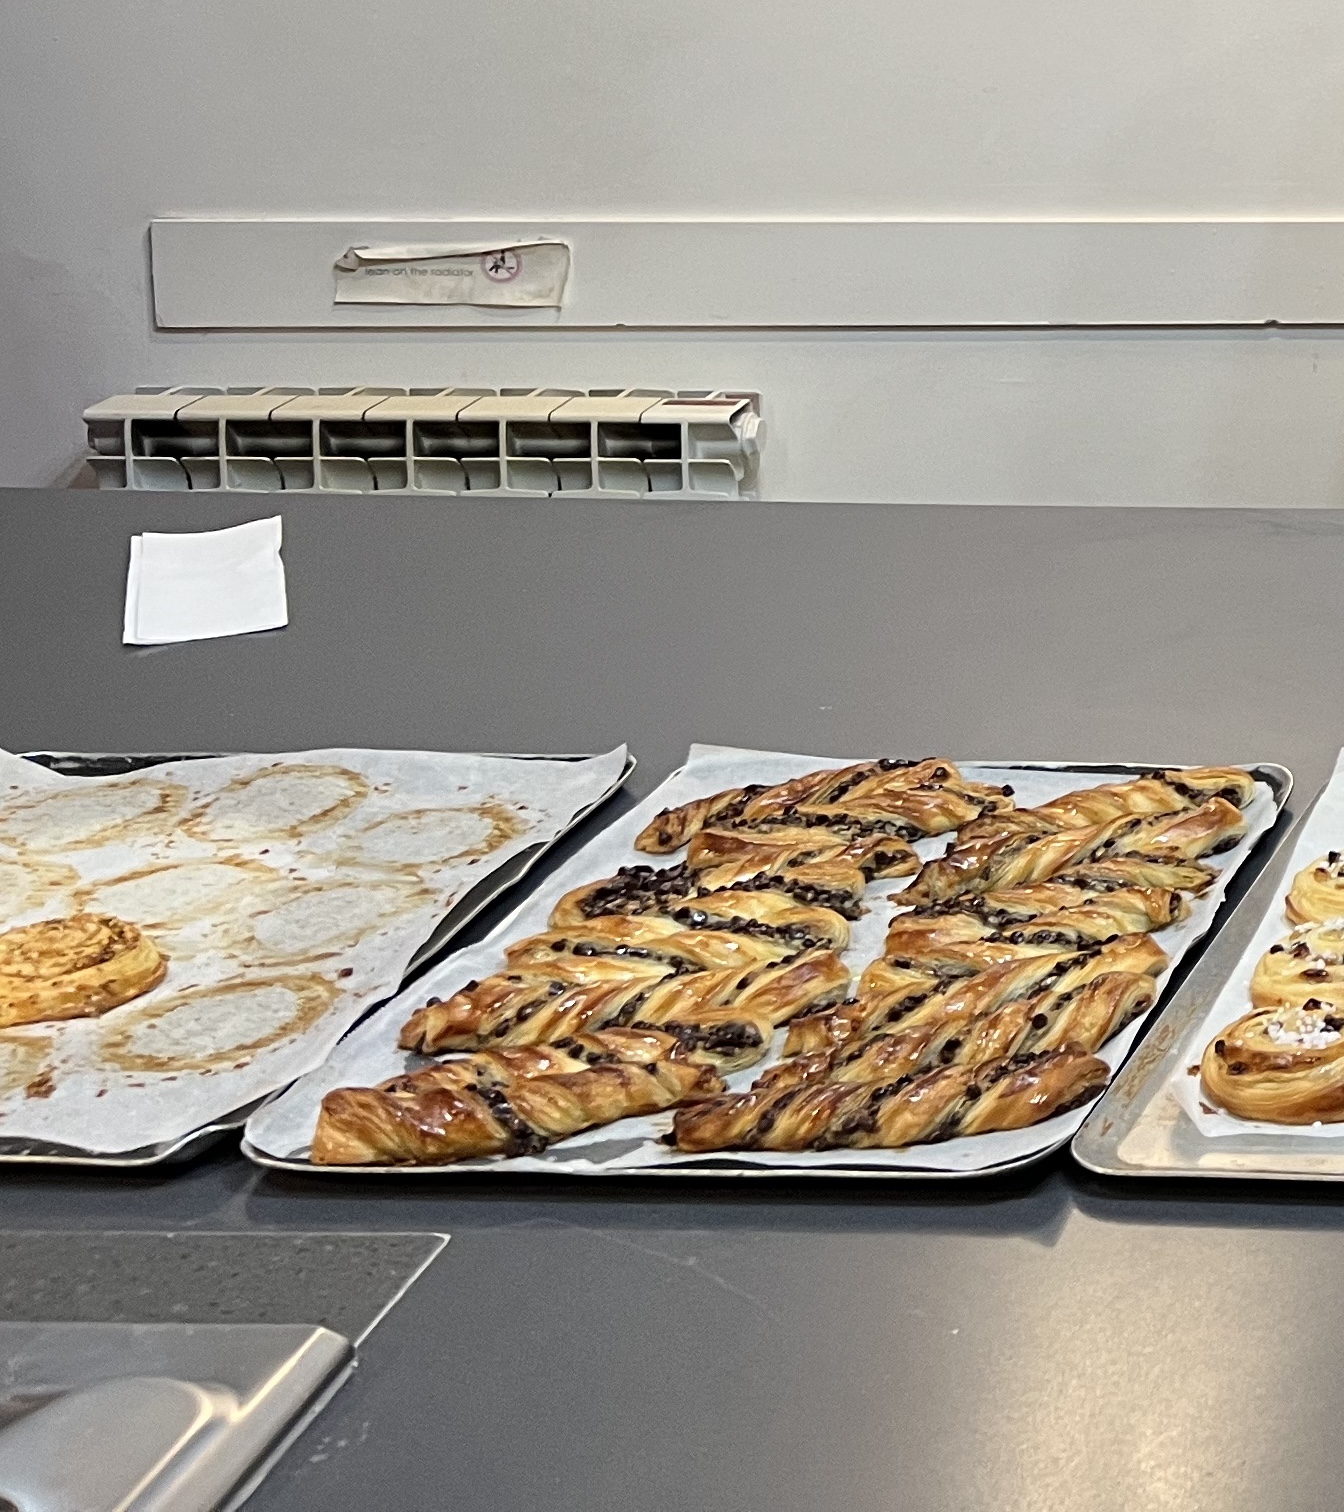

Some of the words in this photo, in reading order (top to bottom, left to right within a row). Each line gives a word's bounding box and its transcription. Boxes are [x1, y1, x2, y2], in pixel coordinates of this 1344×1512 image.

[364, 268, 390, 276] lean
[392, 268, 407, 276] on
[409, 267, 428, 276] the
[430, 267, 475, 277] radiator
